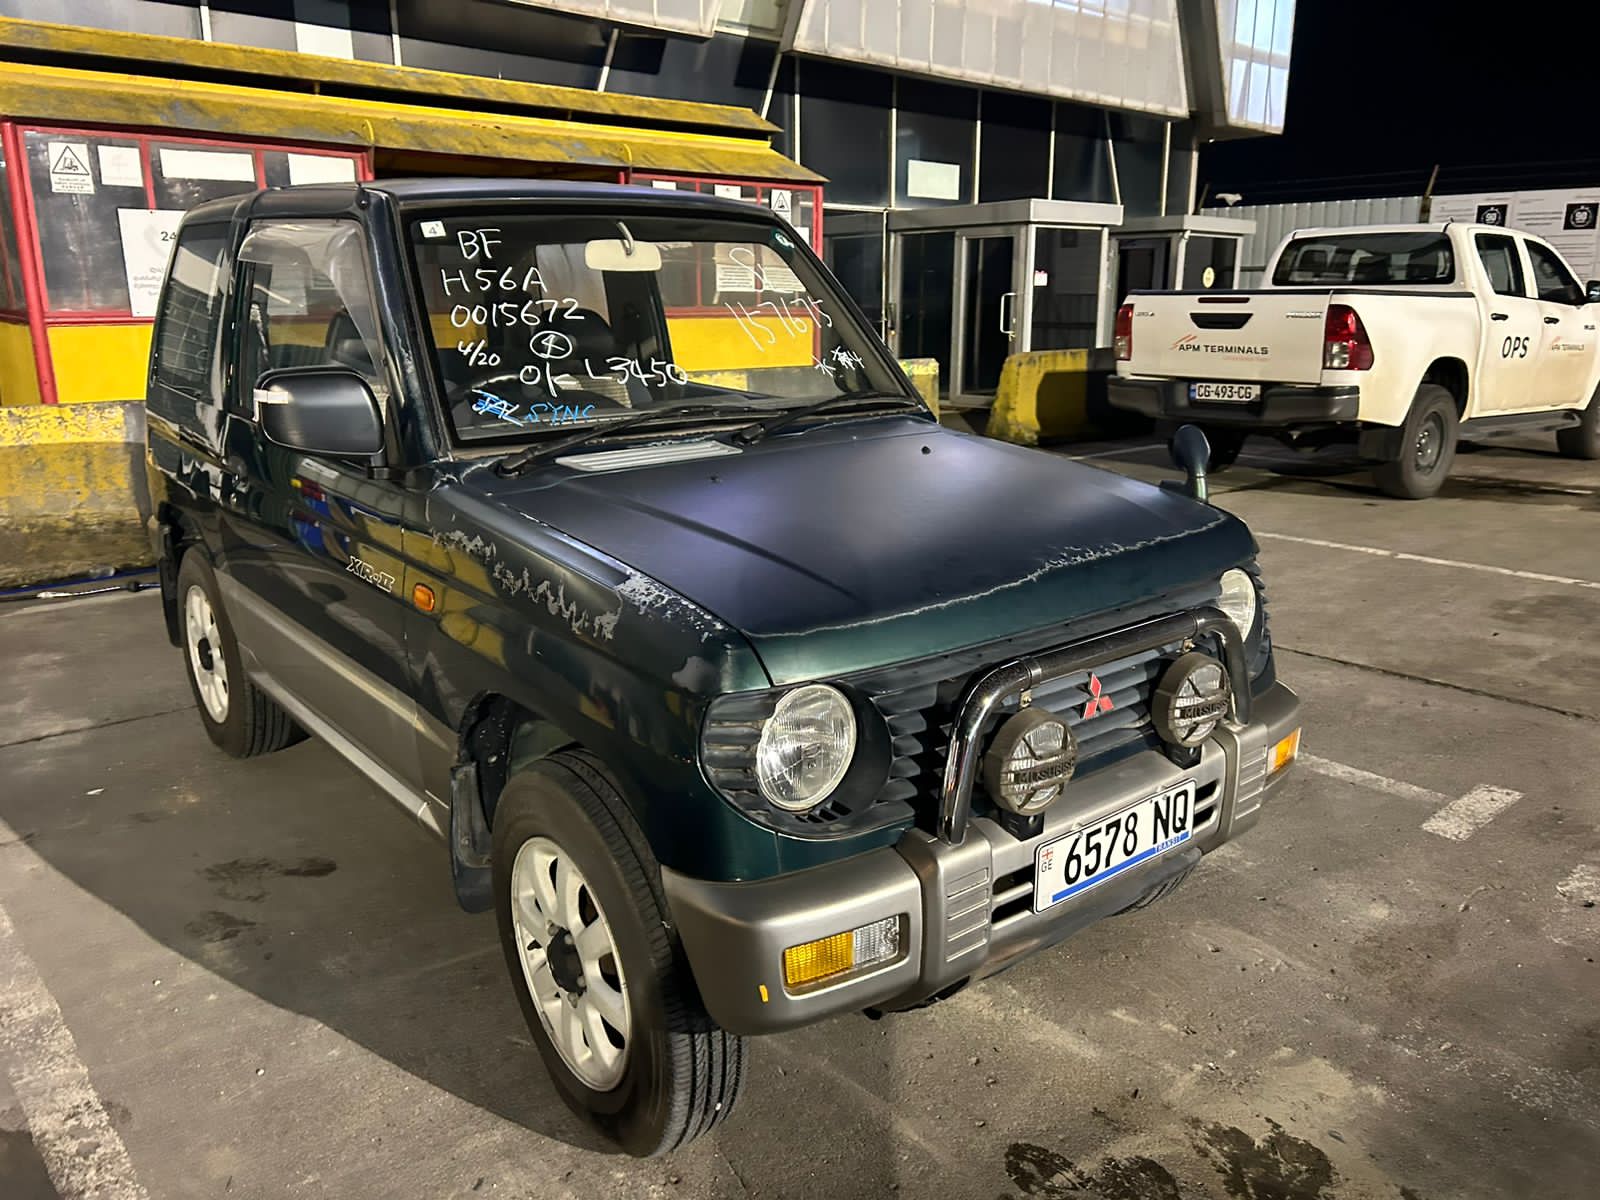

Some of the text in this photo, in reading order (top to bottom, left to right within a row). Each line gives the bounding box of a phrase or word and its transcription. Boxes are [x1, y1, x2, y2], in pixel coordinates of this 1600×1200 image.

[457, 229, 502, 260] BF
[441, 266, 548, 296] H56A
[450, 297, 585, 328] 0015672
[458, 339, 501, 367] 4/20
[1178, 344, 1269, 355] APM TERMINALS
[1502, 336, 1530, 358] OPS
[1197, 384, 1252, 399] CG-493-CG
[1064, 789, 1189, 886] 6578 NQ
[1041, 859, 1053, 873] GE
